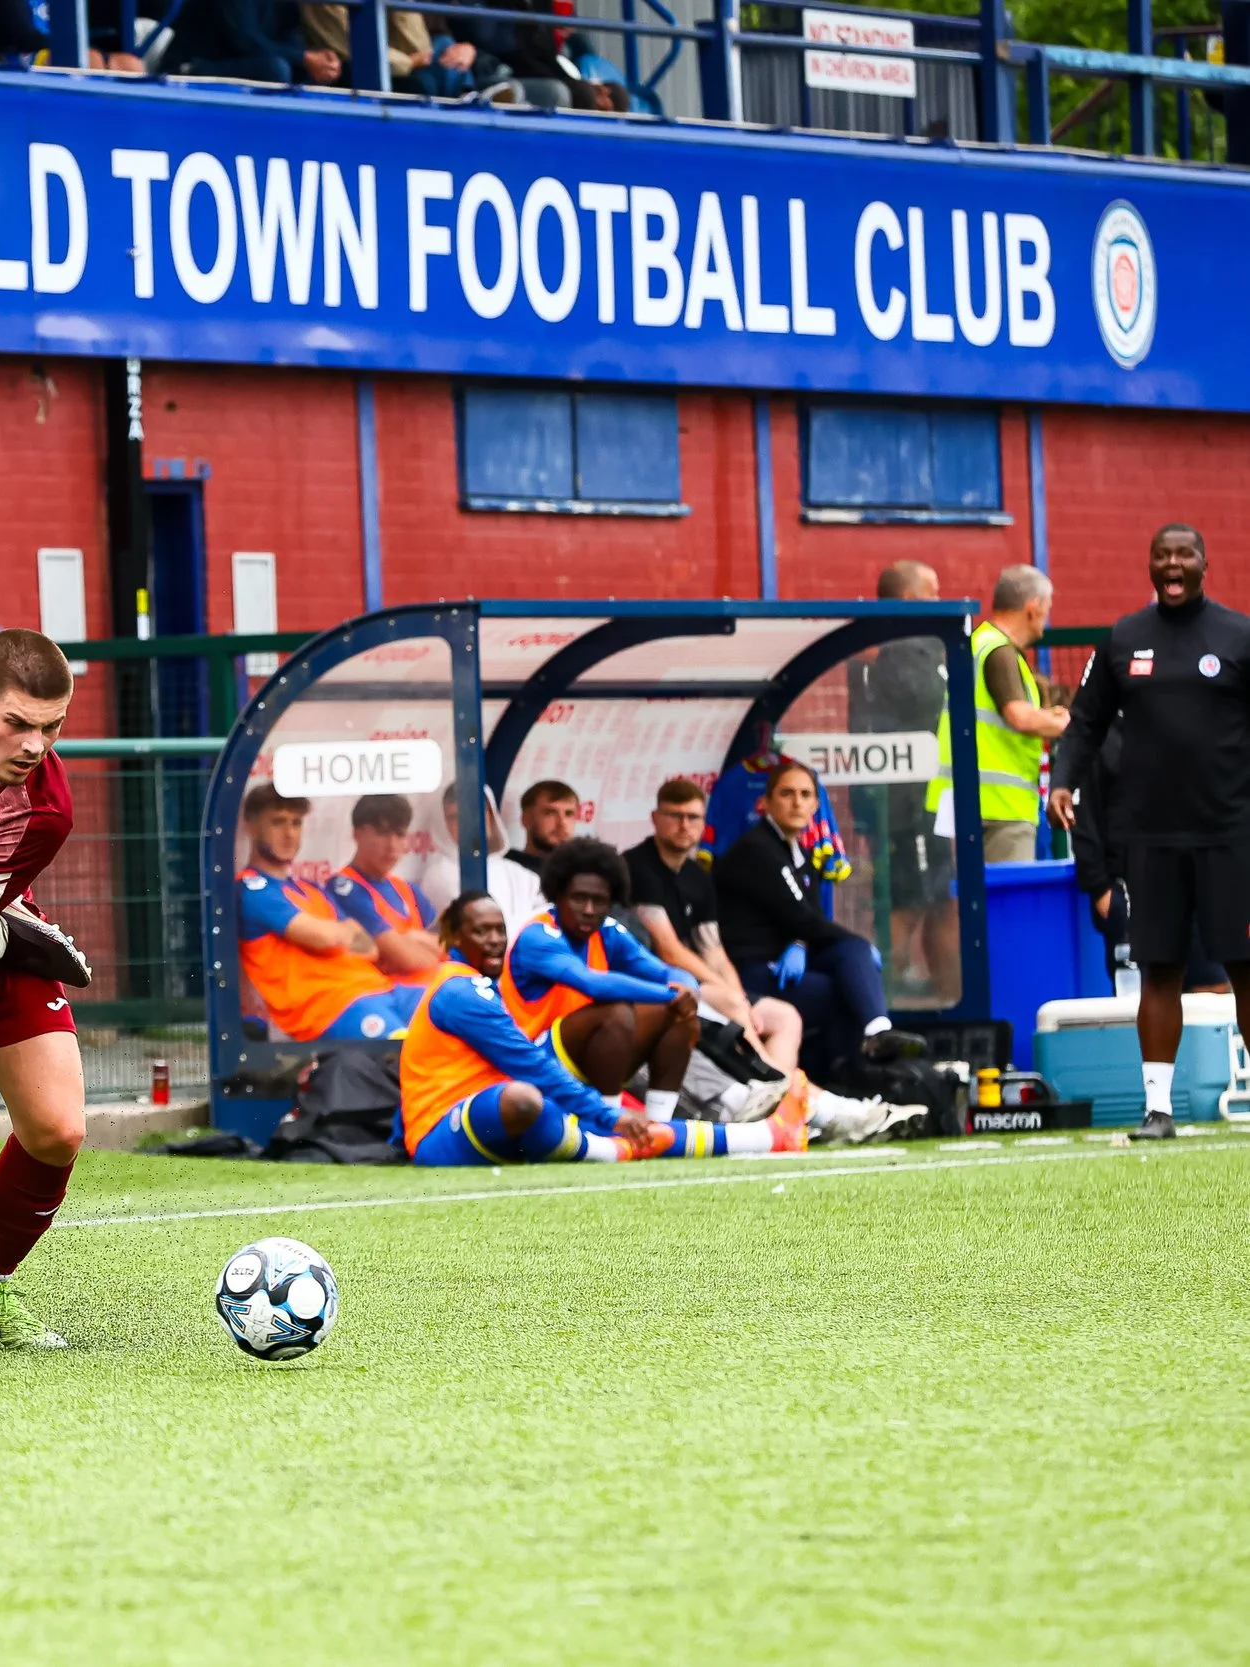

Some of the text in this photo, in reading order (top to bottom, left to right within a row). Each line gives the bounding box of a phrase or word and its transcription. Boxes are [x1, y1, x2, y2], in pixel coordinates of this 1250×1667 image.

[809, 22, 830, 41] NO
[111, 148, 379, 309] TOWN
[406, 168, 836, 336] FOOTBALL
[854, 201, 1056, 347] CLUB
[302, 752, 411, 785] HOME
